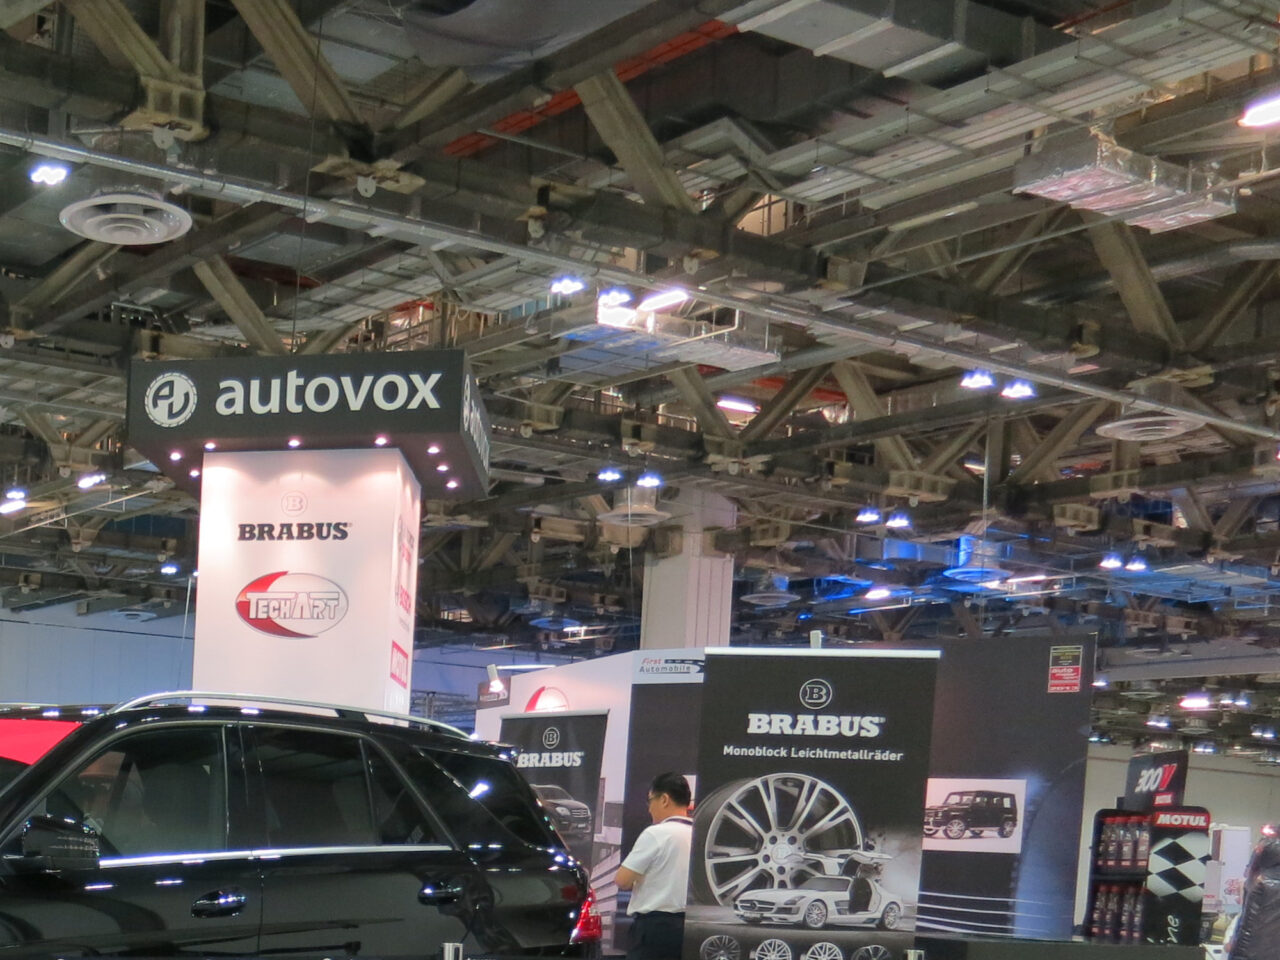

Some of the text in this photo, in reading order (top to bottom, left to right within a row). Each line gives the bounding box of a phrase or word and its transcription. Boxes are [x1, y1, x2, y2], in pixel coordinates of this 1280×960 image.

[215, 369, 442, 416] autovox
[238, 522, 349, 541] BRABUS
[747, 713, 880, 738] BRABUS
[517, 751, 582, 768] BRABUS
[723, 744, 904, 761] Monoblock Leichtmetallräder
[1156, 813, 1207, 826] MOTUL
